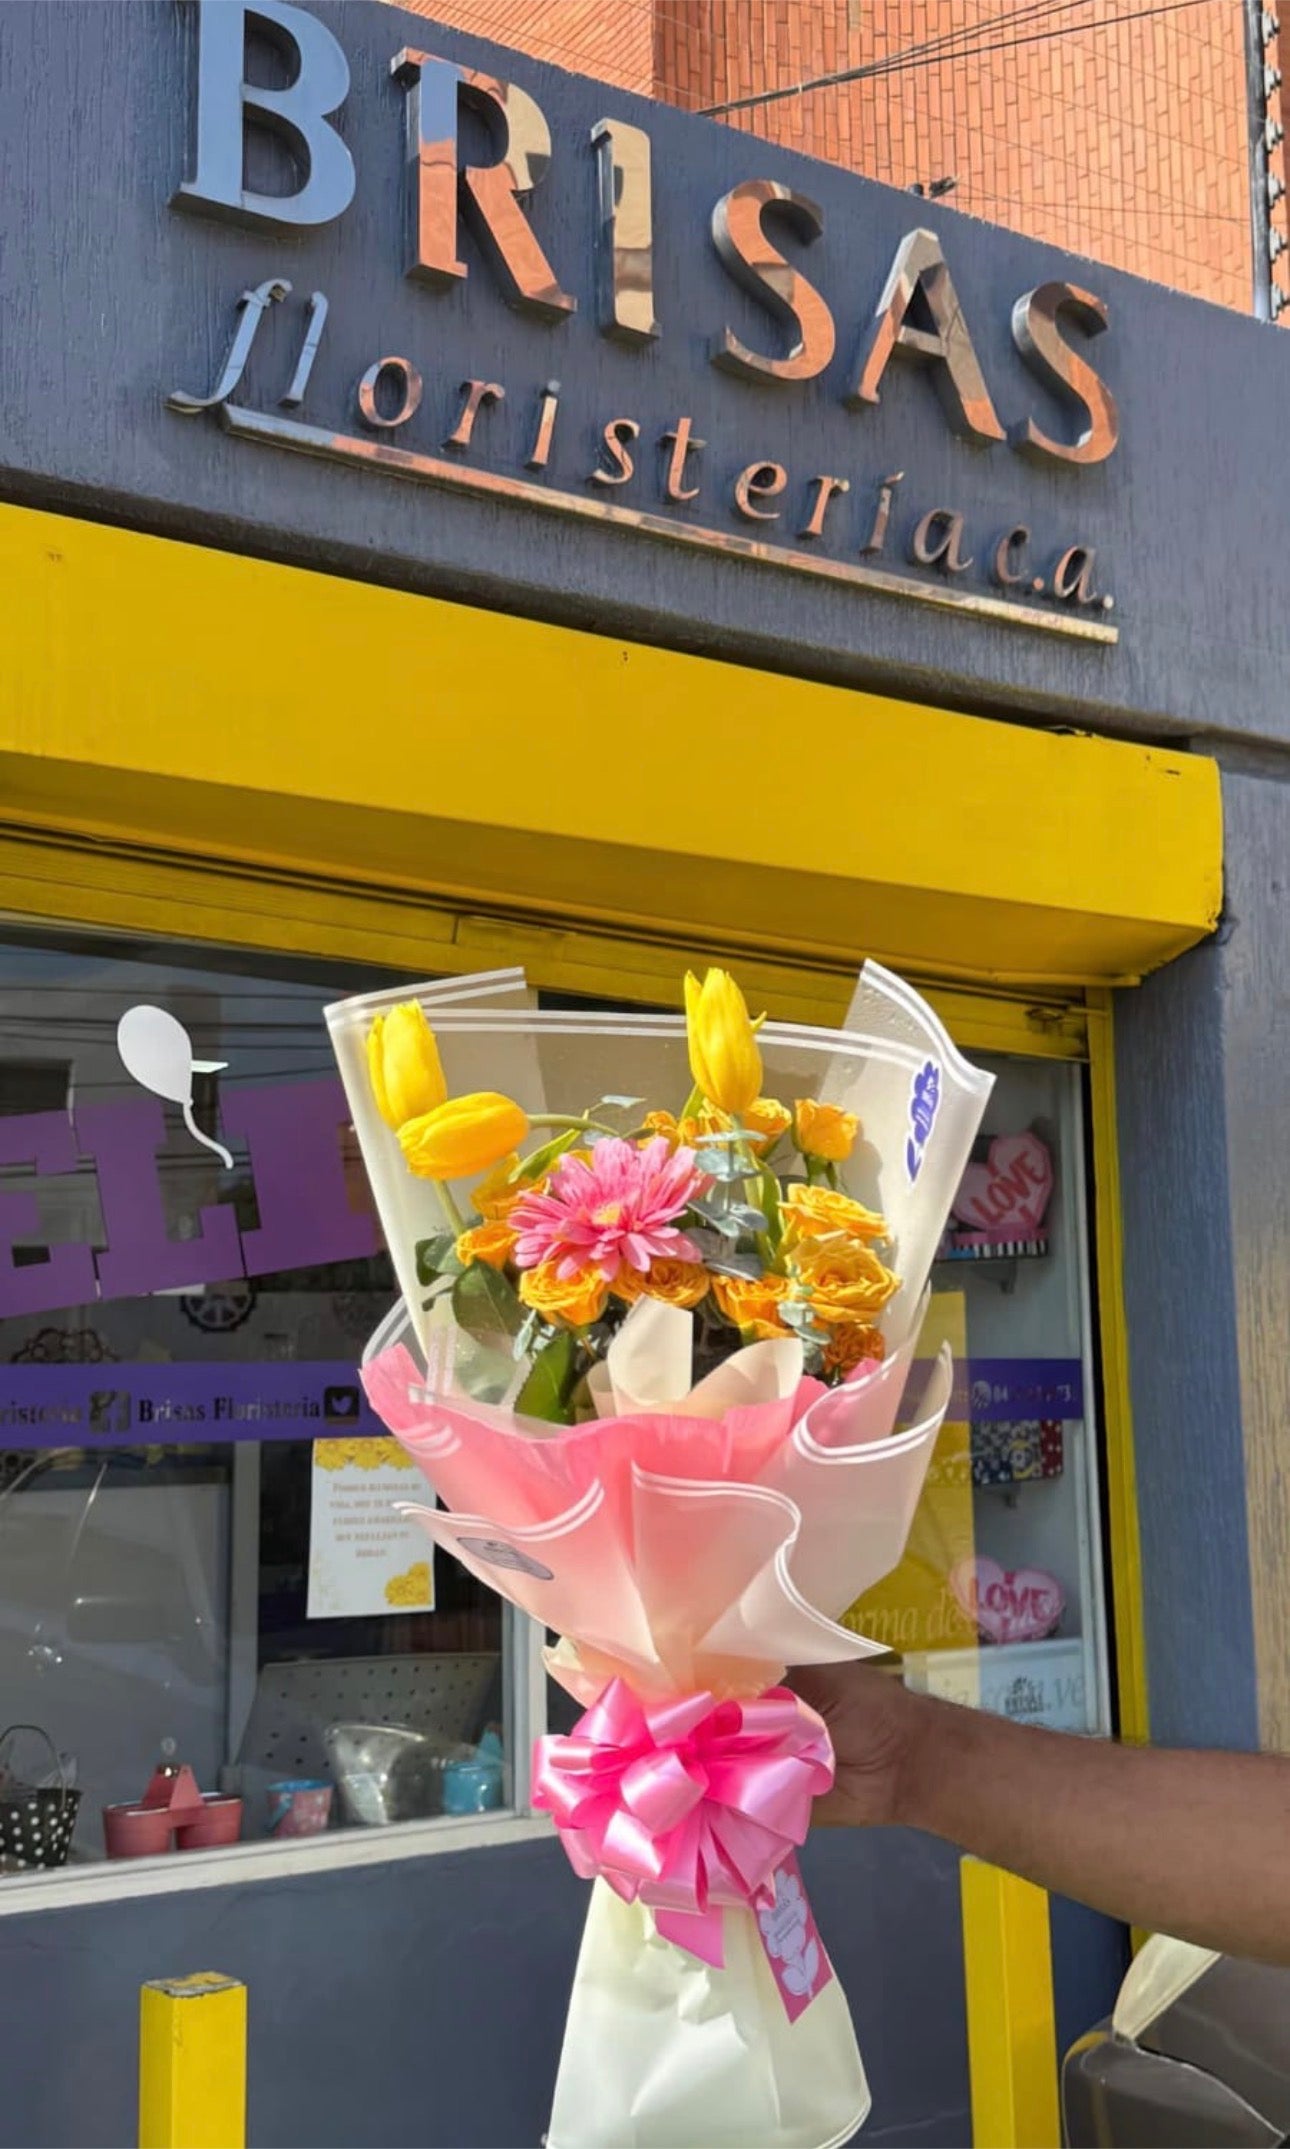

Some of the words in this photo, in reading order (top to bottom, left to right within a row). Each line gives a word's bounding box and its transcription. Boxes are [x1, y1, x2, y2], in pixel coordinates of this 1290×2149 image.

[170, 0, 1121, 466] BRISAS
[165, 278, 976, 574] floristería
[994, 522, 1115, 611] c.a.
[969, 1149, 1048, 1226] LOVE
[138, 1397, 206, 1424] Brisas
[968, 1578, 1051, 1622] LOVE
